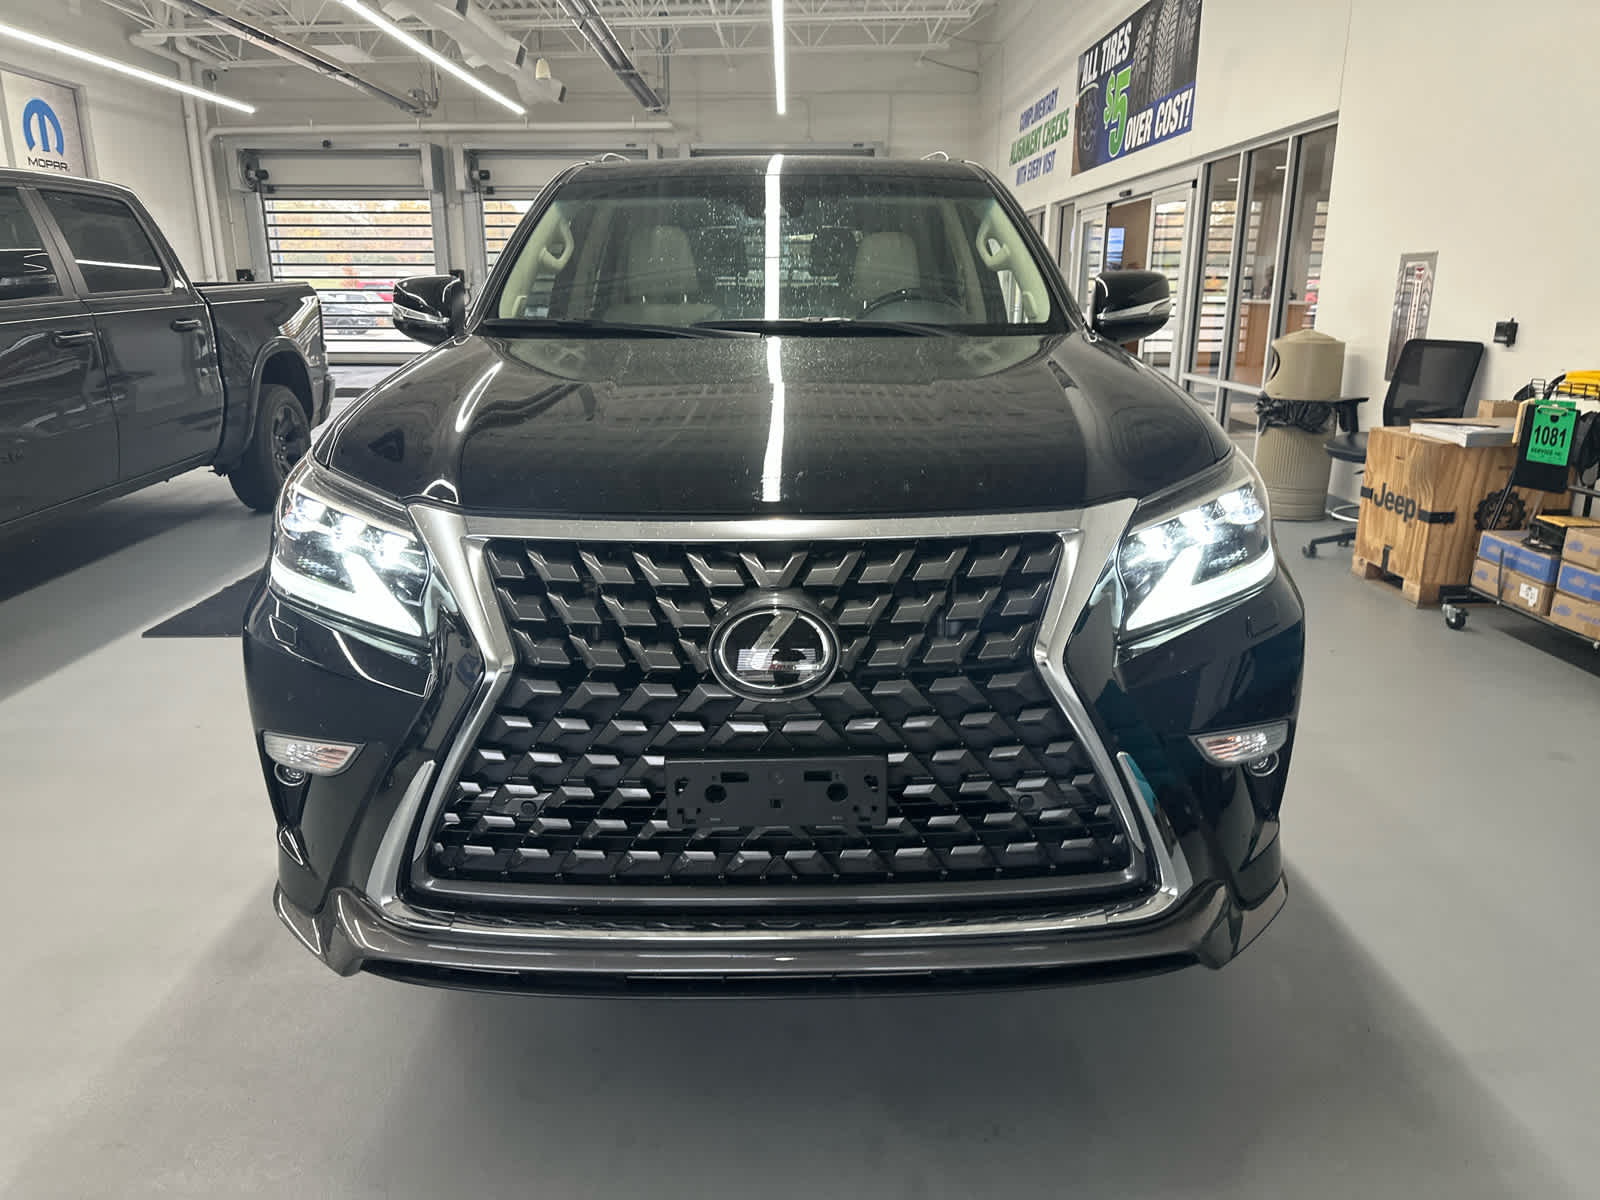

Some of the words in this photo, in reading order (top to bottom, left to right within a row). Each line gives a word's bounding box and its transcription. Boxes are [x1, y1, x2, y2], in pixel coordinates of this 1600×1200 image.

[1081, 46, 1099, 89] ALL
[1101, 21, 1132, 76] TIRES
[1042, 107, 1070, 149] CHECKS
[1103, 65, 1132, 158] $5
[1124, 107, 1154, 152] OVER
[1154, 87, 1194, 140] COST!
[27, 156, 69, 171] MOPAR
[1535, 424, 1567, 448] 1081
[1373, 482, 1417, 523] Jeep
